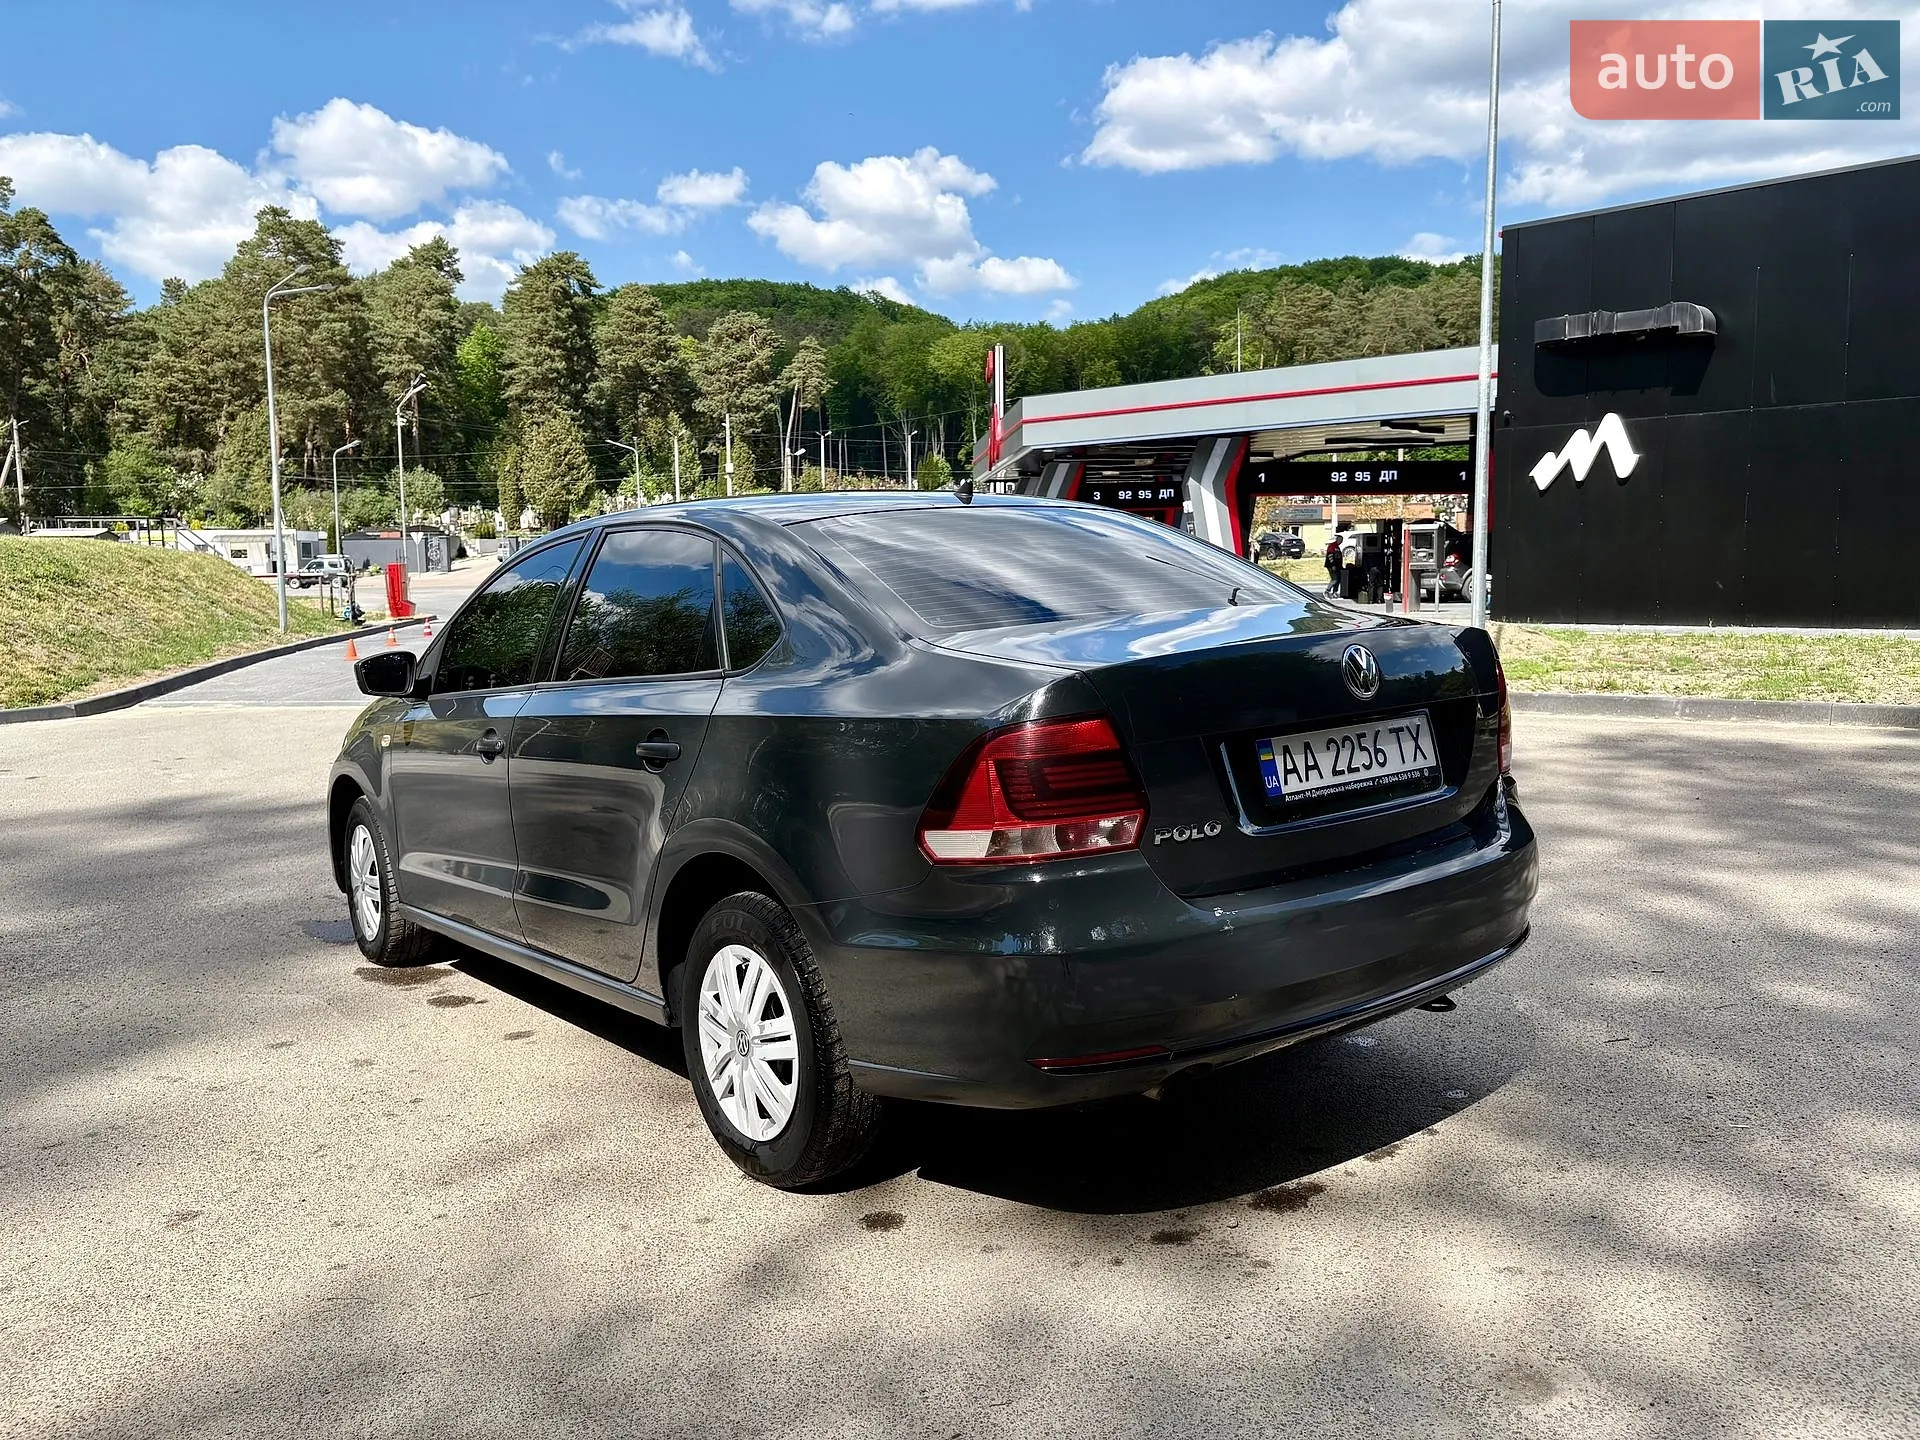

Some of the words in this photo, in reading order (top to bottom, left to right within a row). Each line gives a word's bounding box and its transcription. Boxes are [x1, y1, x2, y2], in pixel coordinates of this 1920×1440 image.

[1258, 472, 1266, 483] 1
[1331, 472, 1347, 482] 92
[1354, 471, 1371, 482] 95
[1379, 470, 1398, 482] ДП
[1459, 471, 1467, 481] 1
[1093, 491, 1101, 500] 3
[1118, 490, 1132, 500] 92
[1138, 489, 1152, 499] 95
[1158, 488, 1174, 500] ДП
[1282, 740, 1324, 786] AA
[1326, 729, 1388, 777] 2256
[1389, 723, 1428, 765] TX
[1265, 775, 1280, 789] UA
[1153, 820, 1222, 845] POLO
